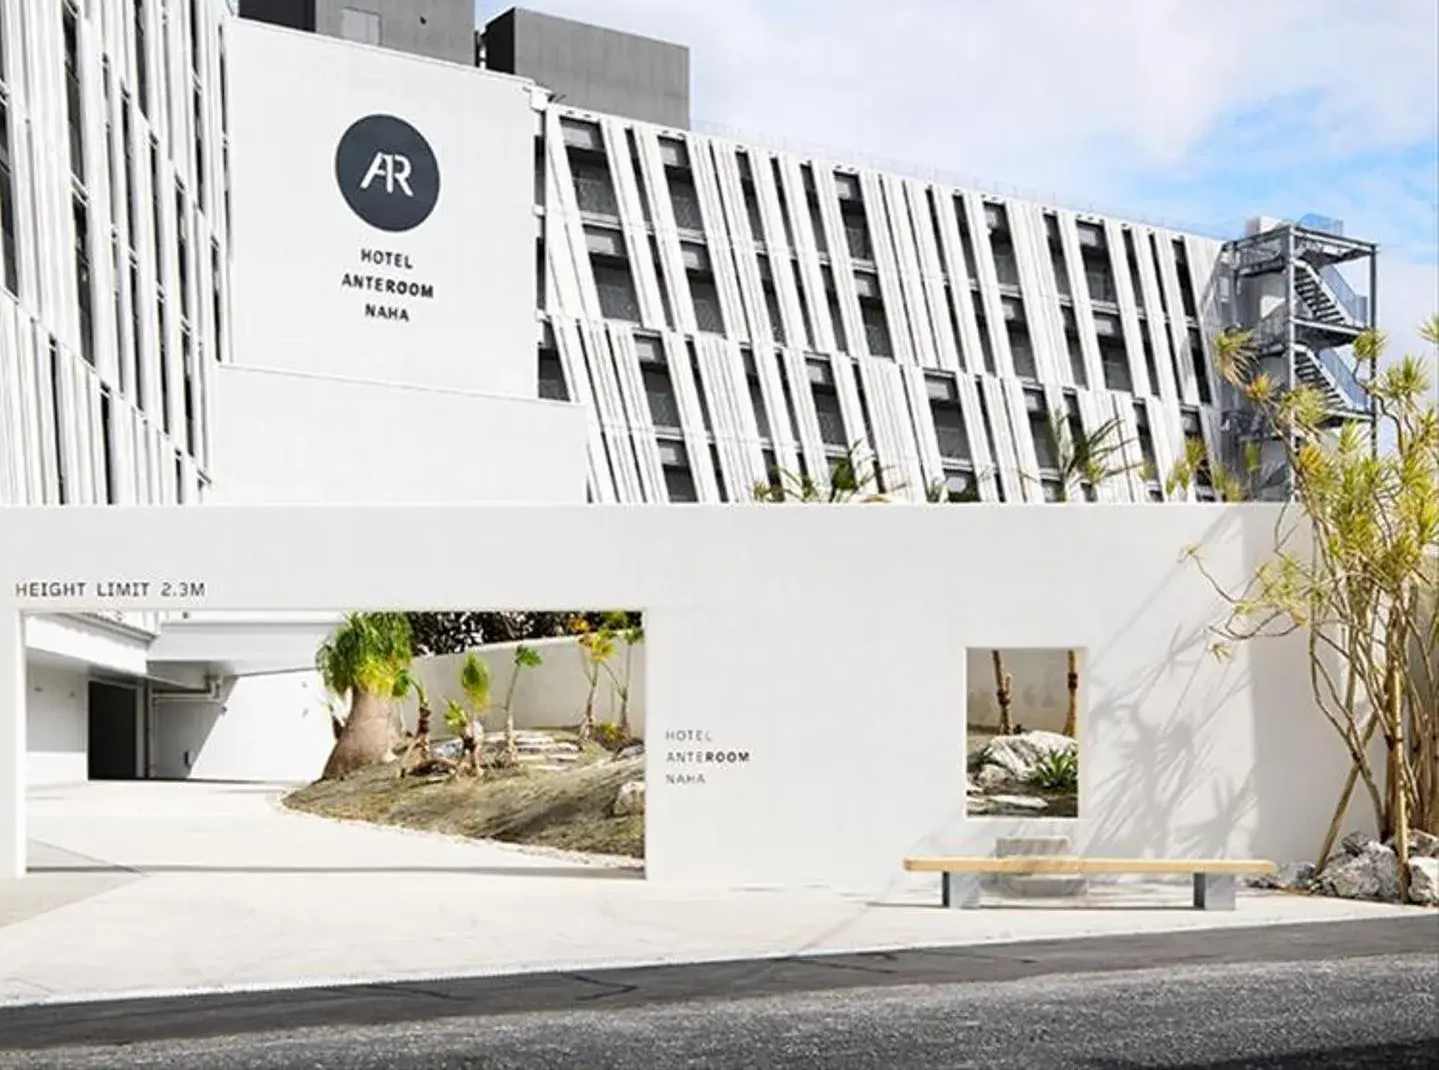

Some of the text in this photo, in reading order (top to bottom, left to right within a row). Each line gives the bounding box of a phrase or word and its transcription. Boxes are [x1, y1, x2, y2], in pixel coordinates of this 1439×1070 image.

[360, 152, 414, 197] AR
[360, 248, 413, 270] HOTEL
[341, 273, 434, 298] ANTEROOM
[364, 303, 410, 322] NAHA
[15, 582, 206, 598] HEIGHT LIMIT 2.3M
[665, 729, 713, 742] HOTEL
[665, 751, 750, 763] ANTEROOM
[665, 773, 706, 785] NAHA
